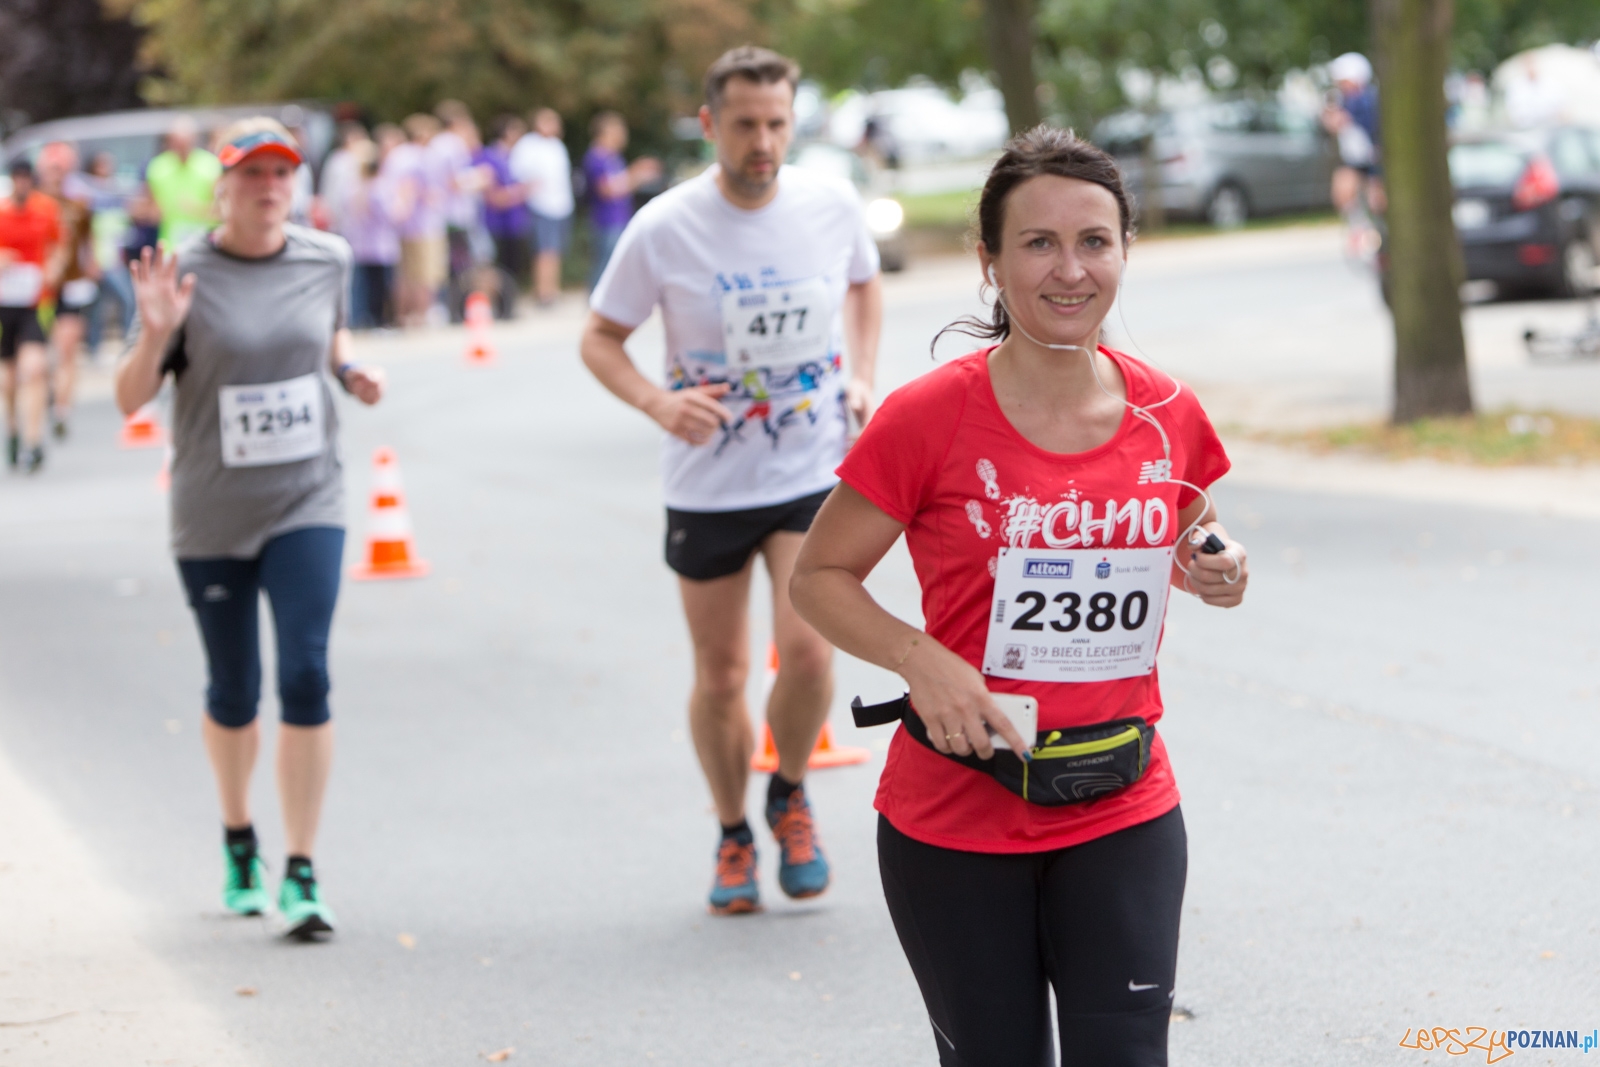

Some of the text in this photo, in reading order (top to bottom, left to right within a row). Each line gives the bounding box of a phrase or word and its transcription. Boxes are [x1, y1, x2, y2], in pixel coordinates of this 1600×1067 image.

[748, 307, 808, 336] 477
[238, 404, 311, 434] 1294
[1003, 497, 1168, 549] #CH10
[1011, 590, 1149, 632] 2380
[1031, 646, 1048, 658] 39
[1051, 646, 1082, 657] BIEG
[1066, 754, 1115, 768] OUTHORN
